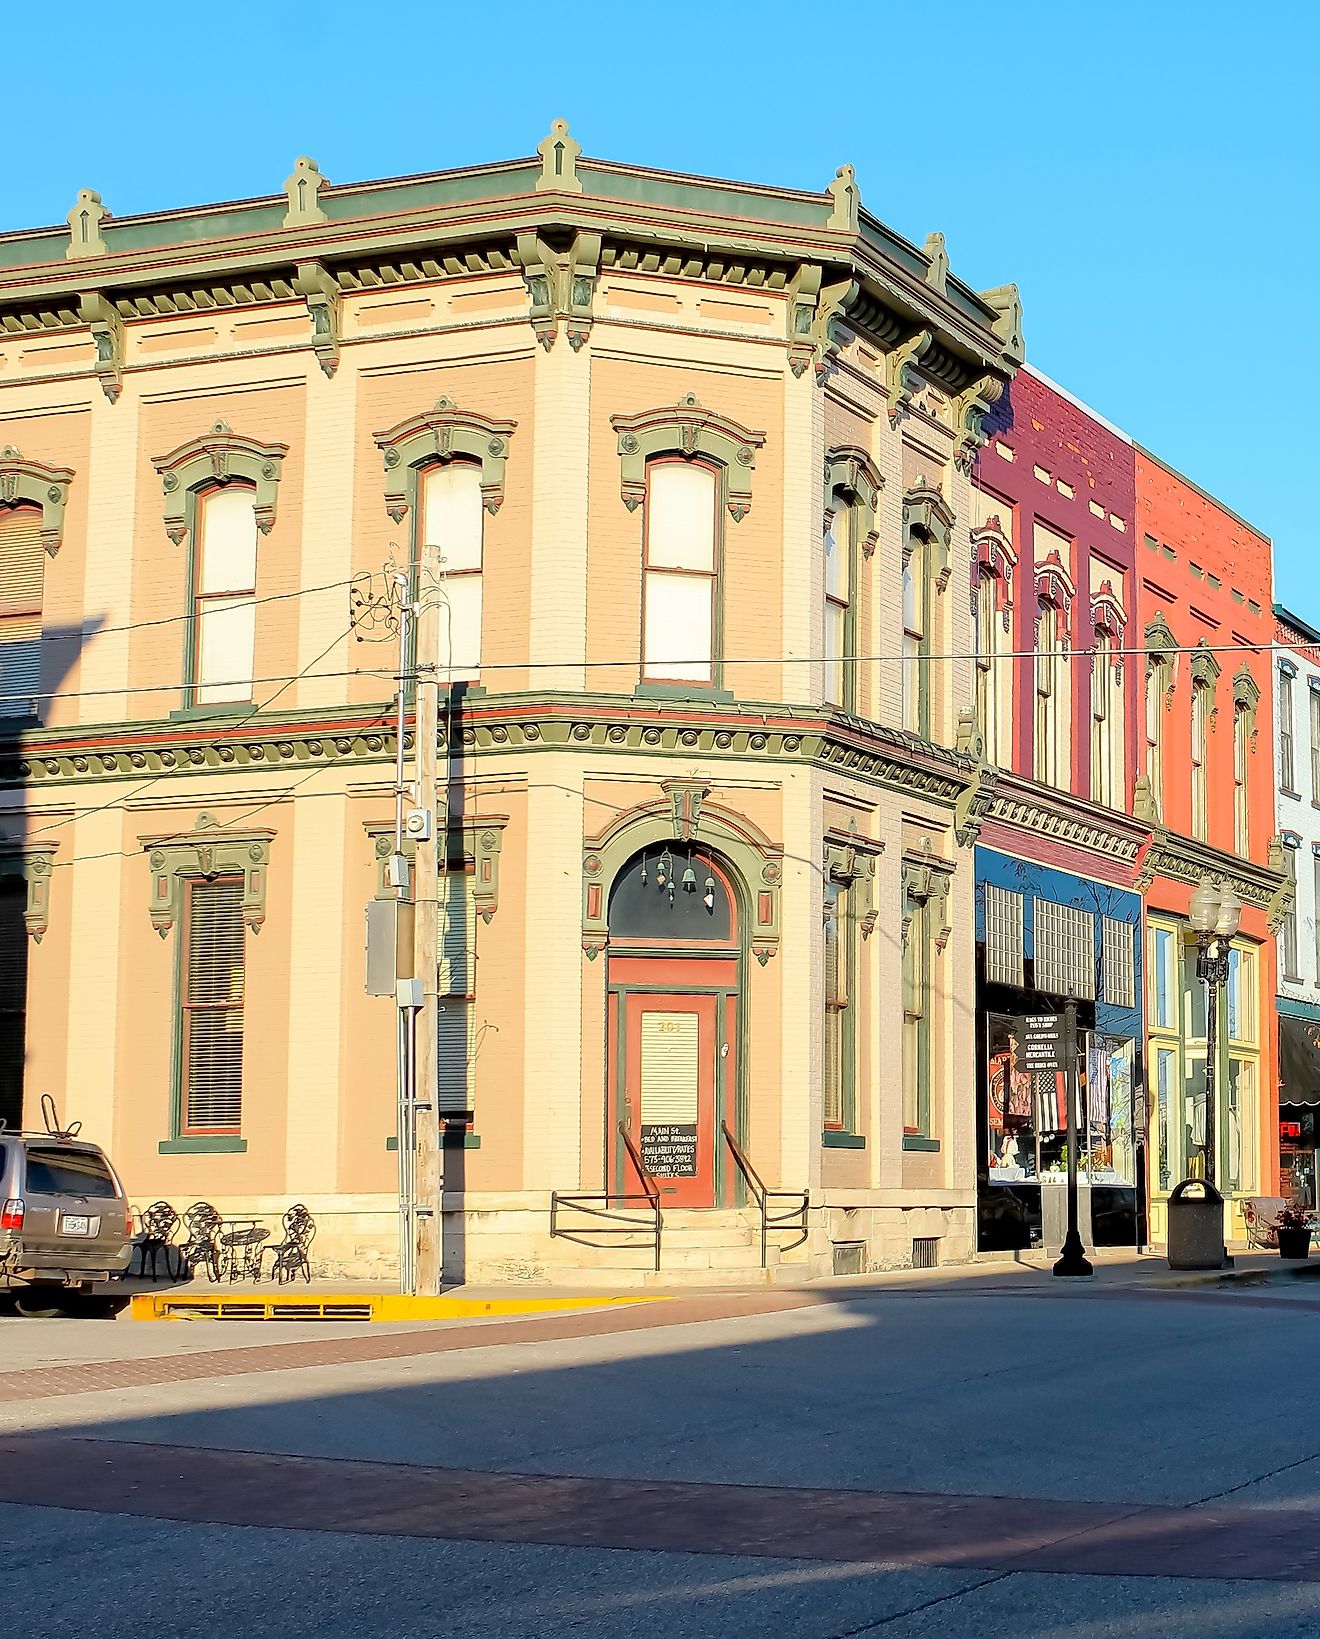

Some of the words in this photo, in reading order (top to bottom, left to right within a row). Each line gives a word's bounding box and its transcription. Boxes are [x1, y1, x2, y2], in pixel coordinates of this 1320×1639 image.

[1025, 1050, 1056, 1059] MERCANTILE
[650, 1126, 669, 1136] MAIN
[656, 1135, 669, 1143] AND
[672, 1163, 694, 1172] FLOOR
